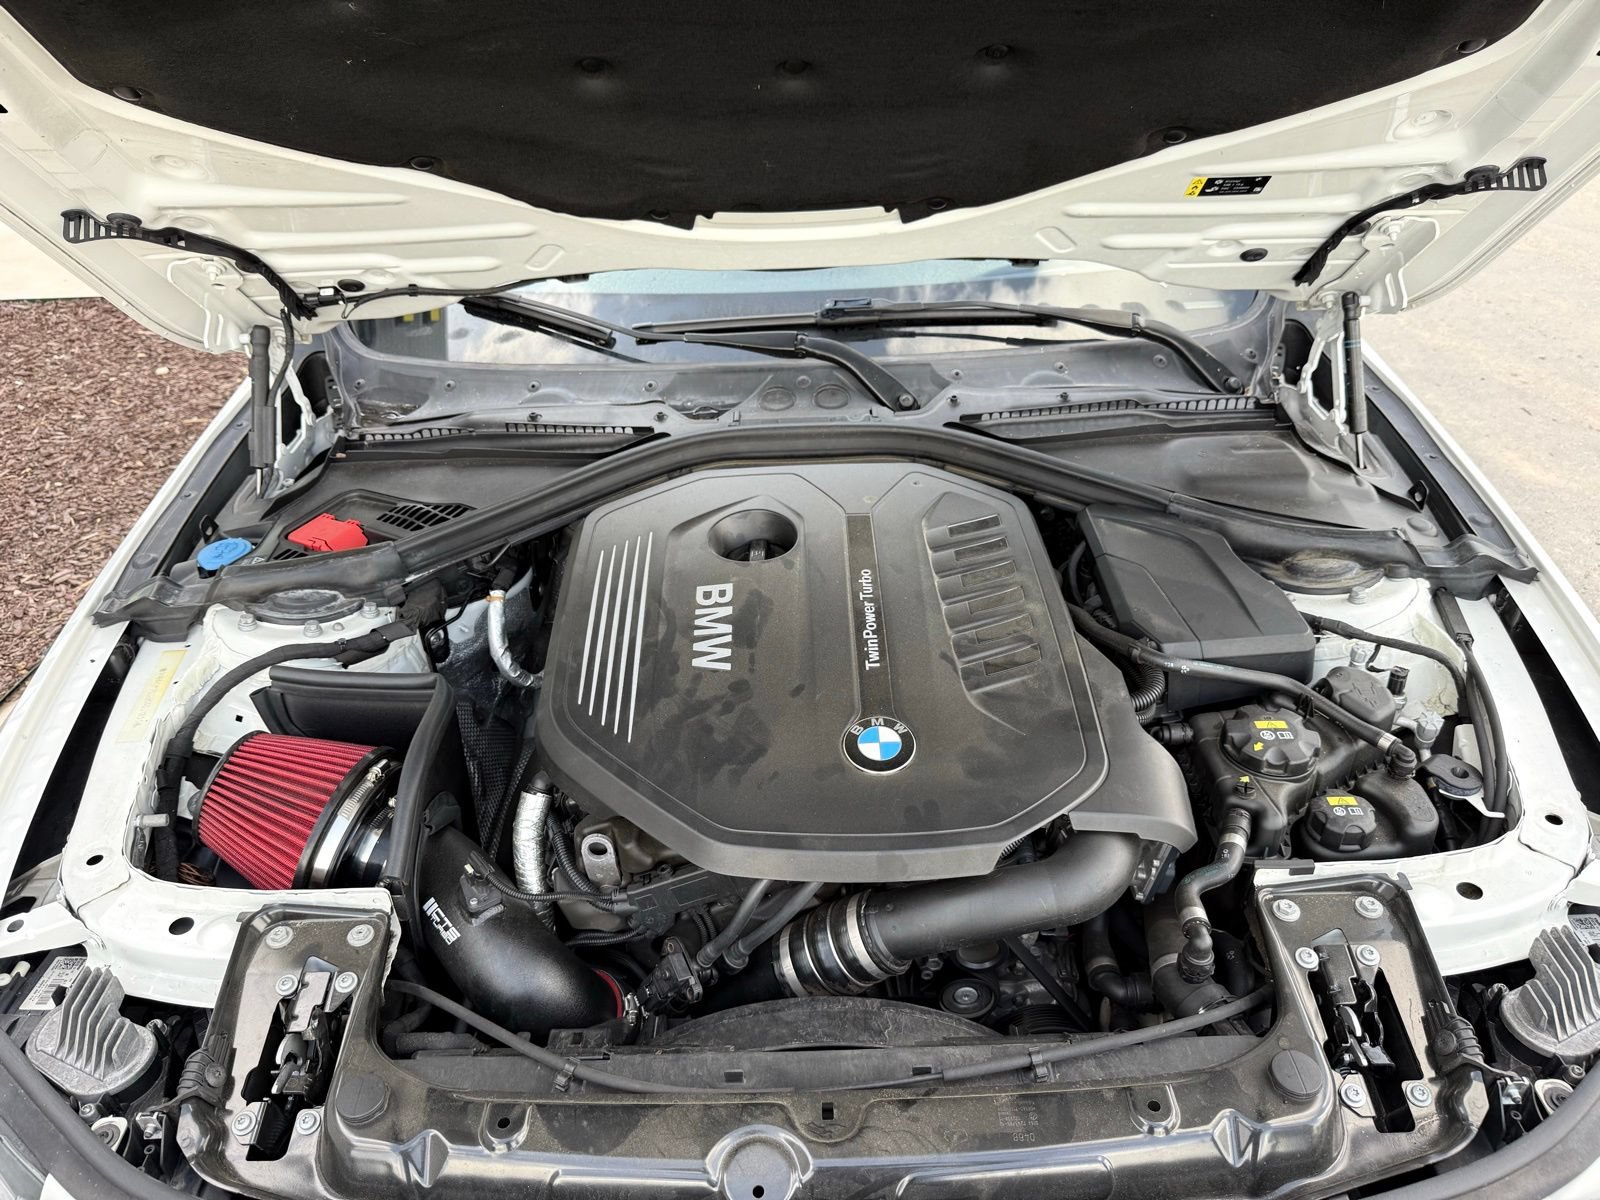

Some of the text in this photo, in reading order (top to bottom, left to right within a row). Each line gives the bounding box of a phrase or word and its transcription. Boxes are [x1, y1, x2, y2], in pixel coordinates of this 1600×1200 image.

[691, 582, 734, 671] BMW
[858, 568, 881, 671] TwinPower Turbo
[850, 717, 909, 736] BMW
